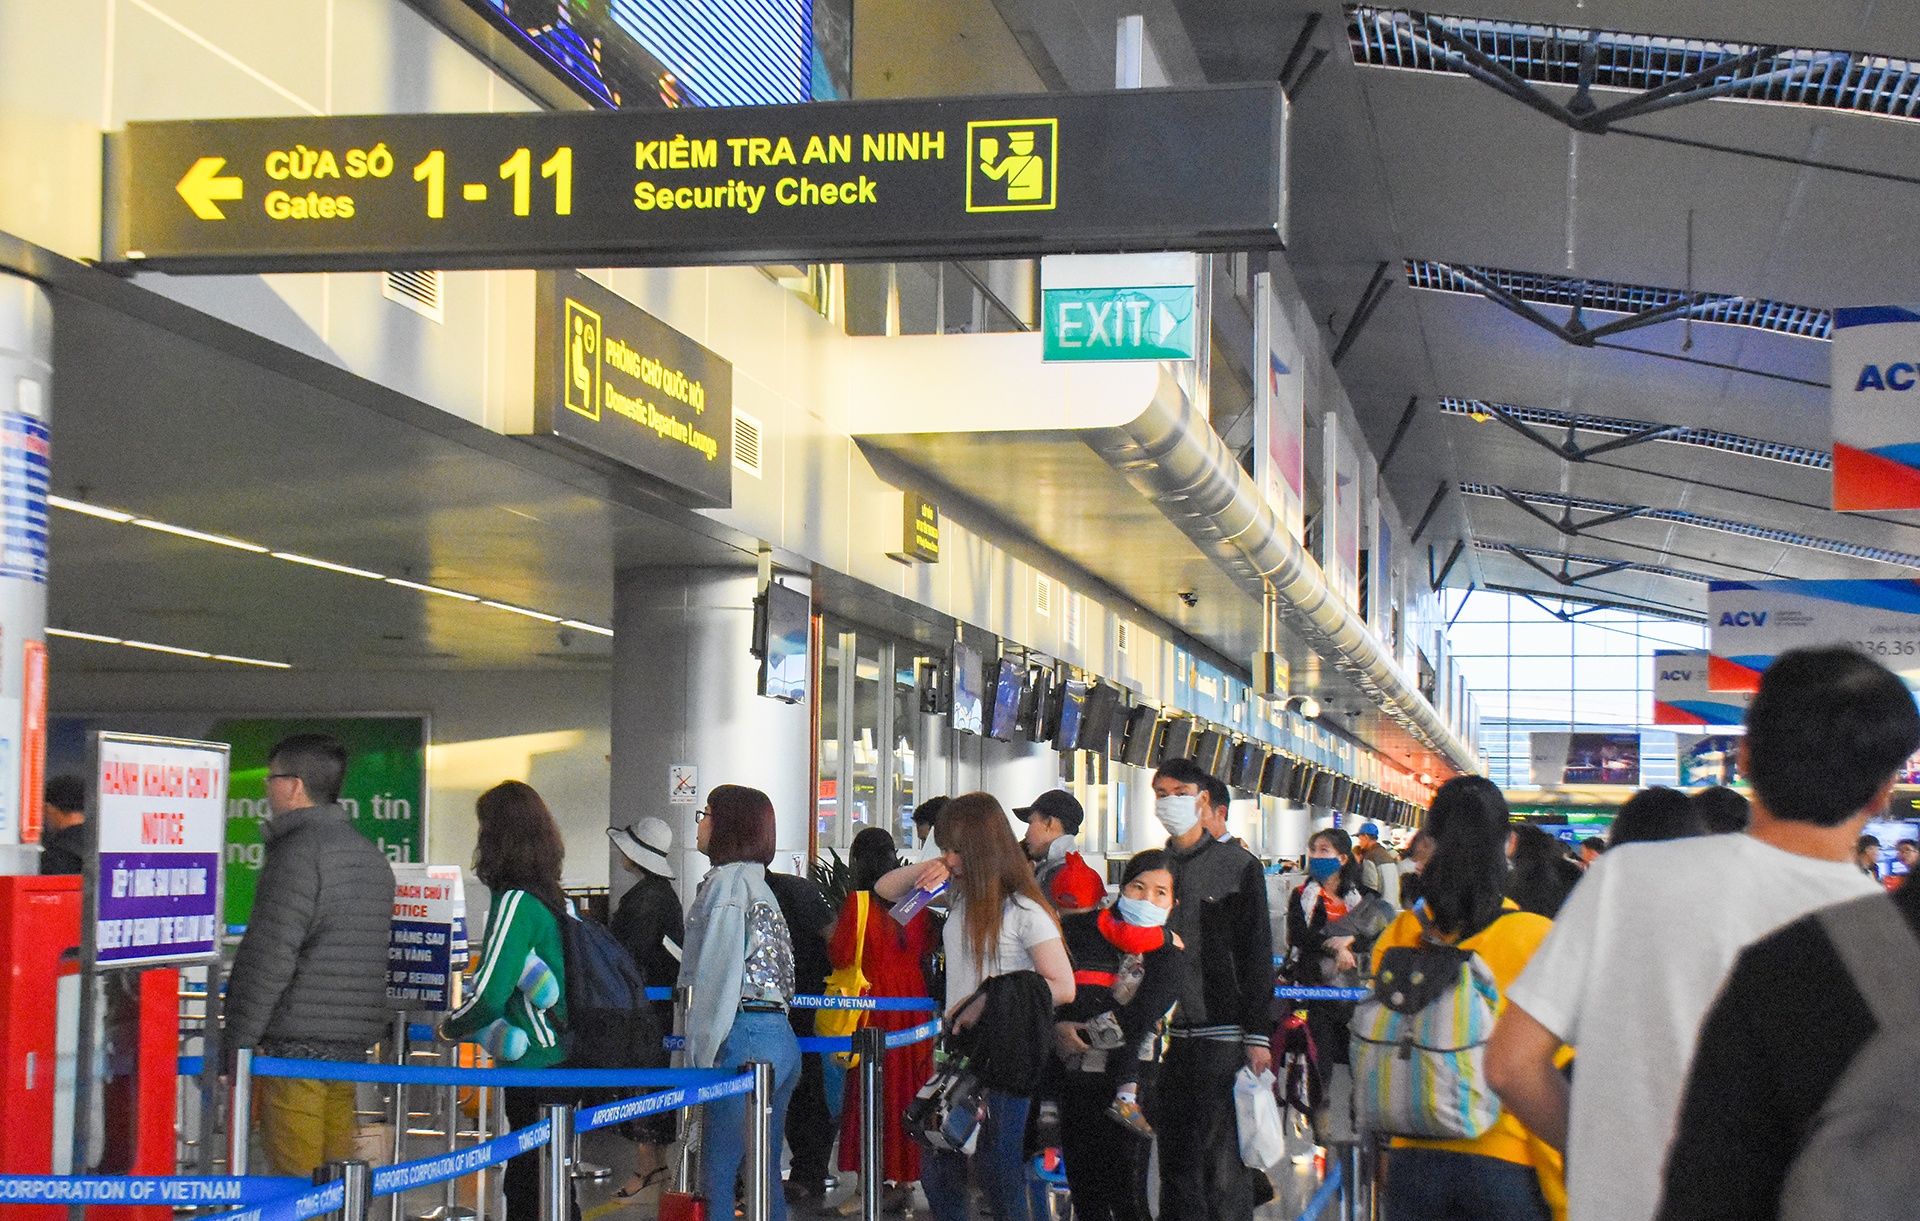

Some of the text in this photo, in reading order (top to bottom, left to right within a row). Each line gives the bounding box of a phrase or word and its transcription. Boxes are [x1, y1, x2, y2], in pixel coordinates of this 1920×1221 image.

[264, 144, 341, 179] CỬA
[635, 131, 945, 169] KIỂM TRA AN NINH
[413, 150, 445, 218] 1
[500, 146, 572, 216] 11
[634, 176, 877, 213] Security Check
[264, 190, 355, 219] Gates
[1059, 301, 1150, 347] EXIT
[605, 337, 641, 379] PHÒNG
[641, 358, 663, 389] CHỜ
[1855, 361, 1920, 391] AC
[605, 381, 718, 461] Domestic Departure Lounge
[1718, 610, 1768, 627] ACV
[1659, 669, 1692, 681] ACV
[372, 792, 411, 819] tin
[395, 883, 421, 899] HÁCH
[393, 903, 427, 917] OTICE
[386, 986, 420, 999] ELLOW
[790, 996, 876, 1009] RATION OF VIETNAM
[1280, 988, 1339, 997] CORPORATION
[591, 1089, 685, 1125] AIRPORTS CORPORATION OF VIETNAM
[376, 1145, 492, 1190] AIRPORTS CORPORATION OF VIETNAM
[0, 1179, 241, 1199] CORPORATION OF VIETNAM
